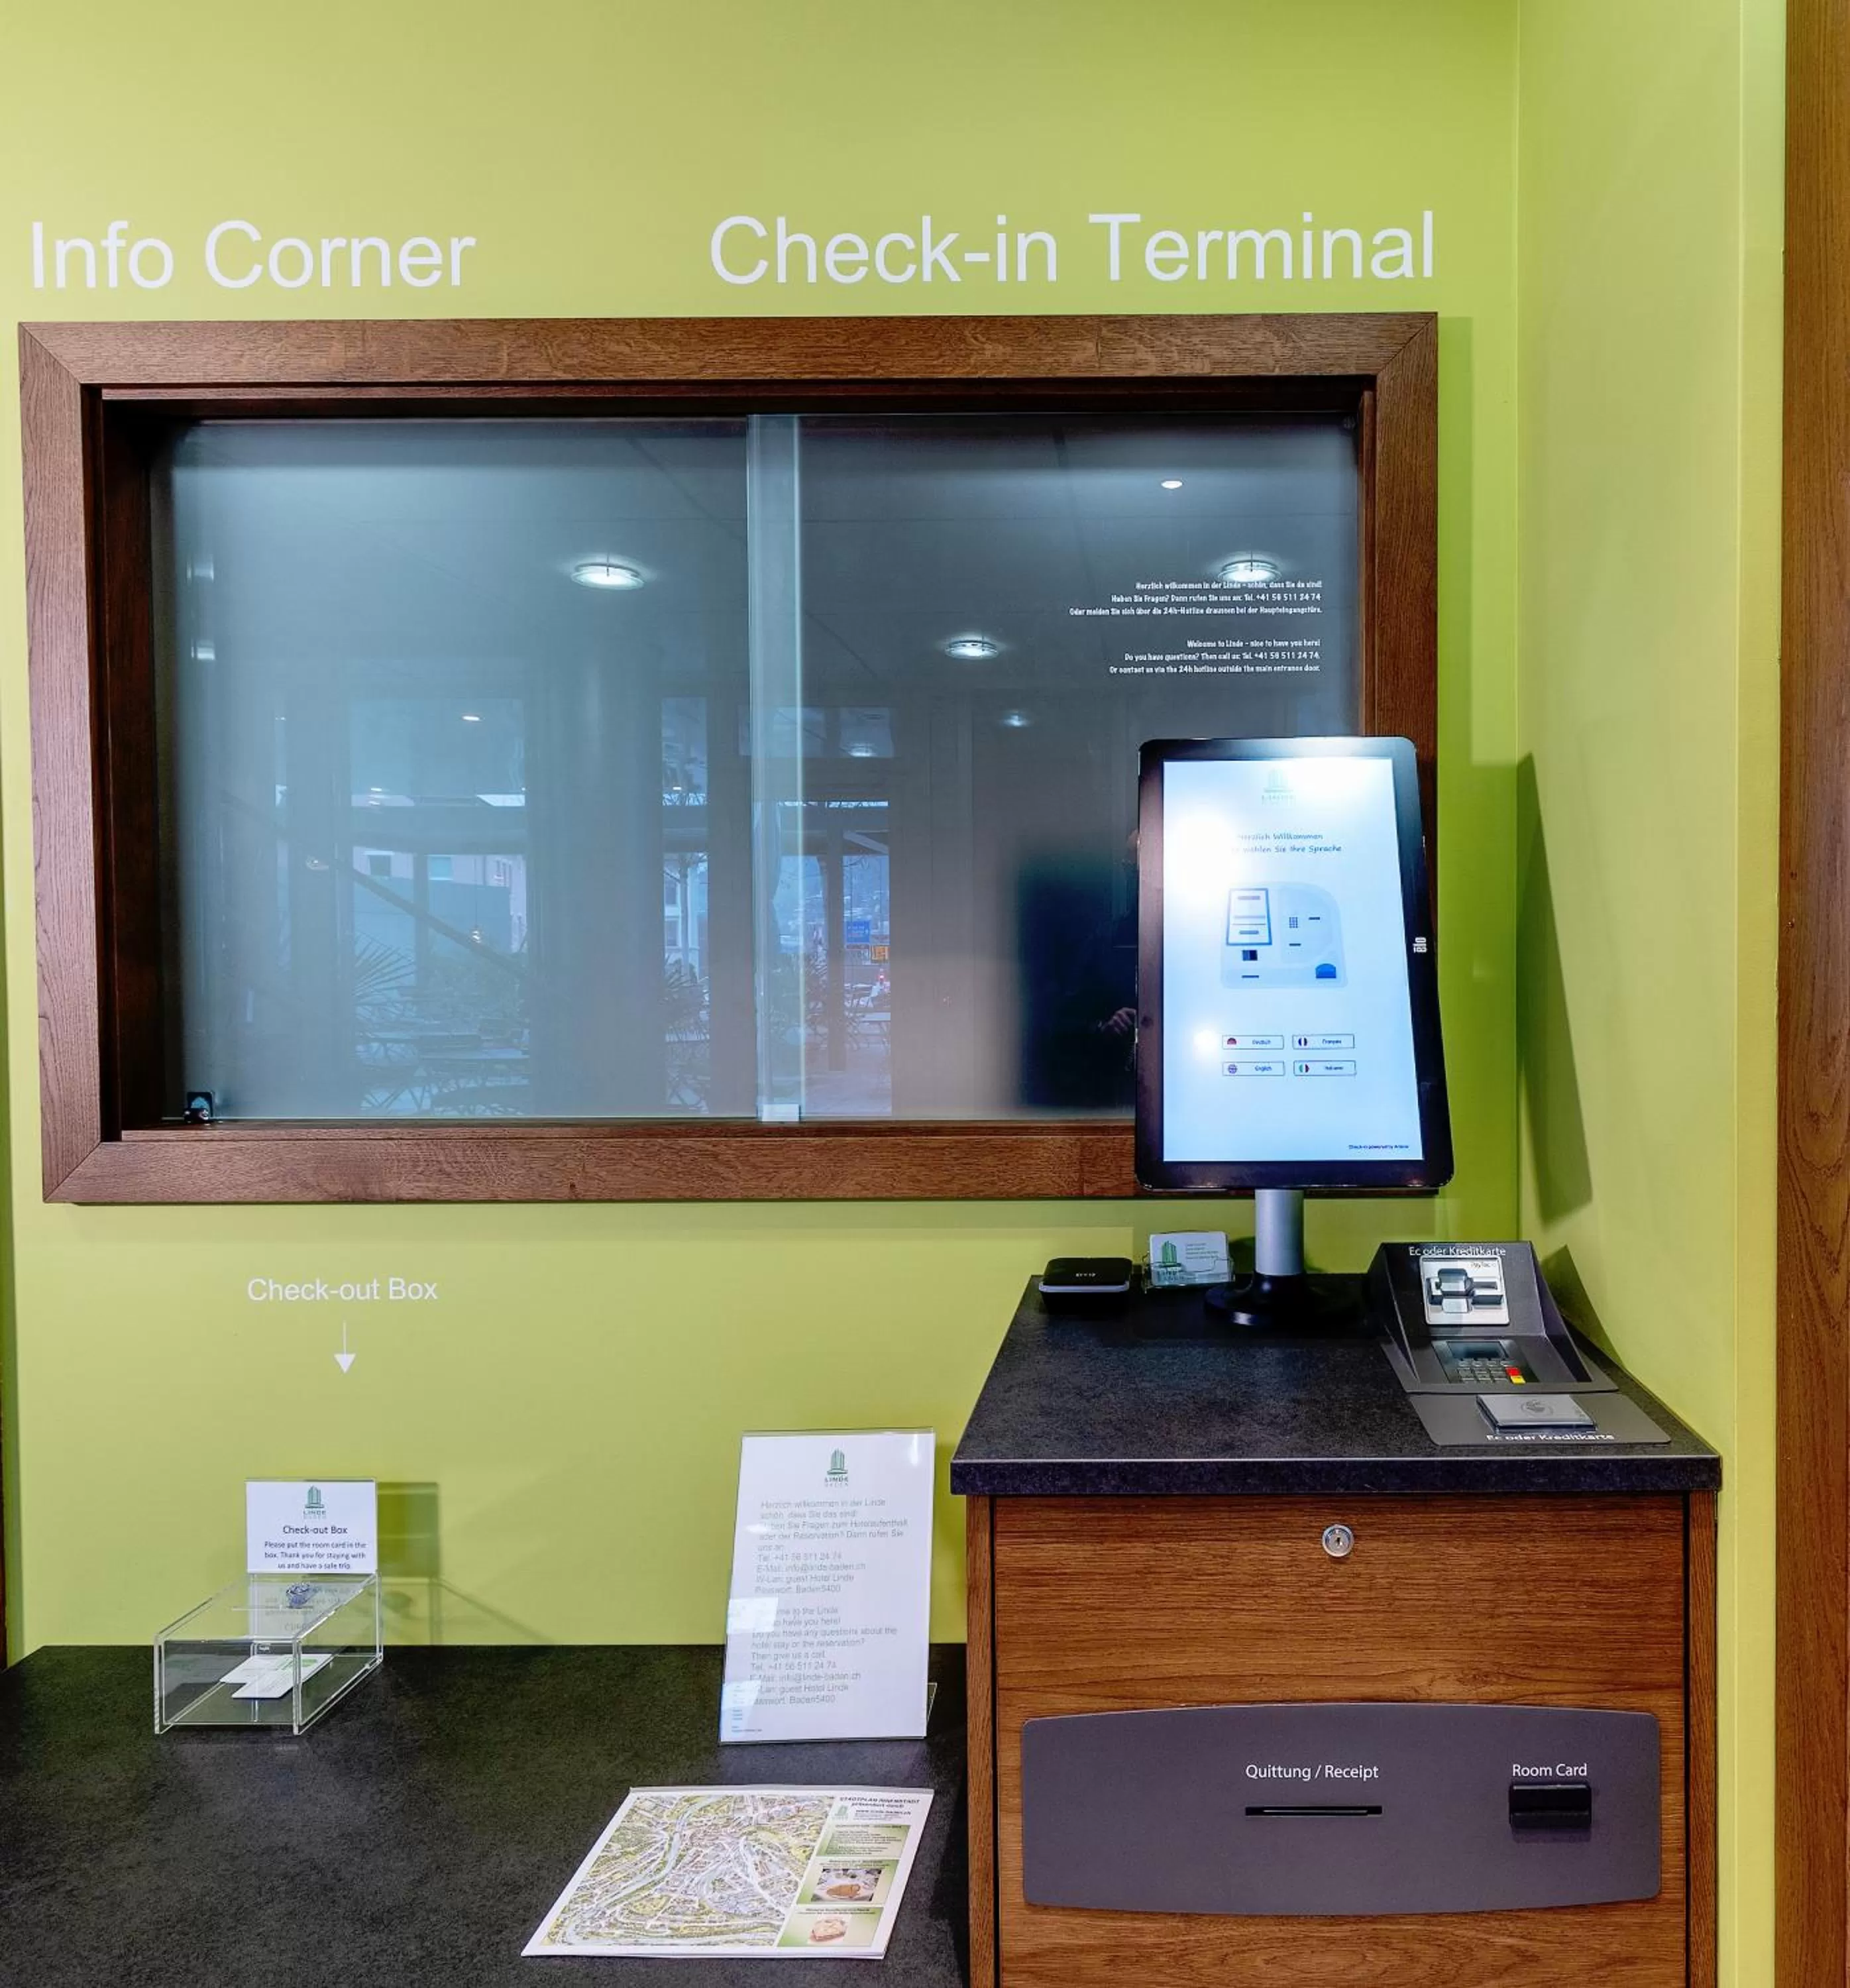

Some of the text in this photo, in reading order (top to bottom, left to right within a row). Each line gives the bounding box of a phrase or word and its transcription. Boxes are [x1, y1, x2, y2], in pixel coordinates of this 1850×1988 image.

[32, 219, 476, 290] Info Corner
[710, 210, 1434, 285] Check-in Terminal
[1409, 1246, 1506, 1256] Ec oder Kreditkarte
[247, 1277, 438, 1301] Check-out Box
[282, 1525, 348, 1534] Check-out Box
[327, 1552, 350, 1561] staying
[1245, 1764, 1379, 1782] Quittung / Receipt
[1511, 1763, 1588, 1777] Room Card
